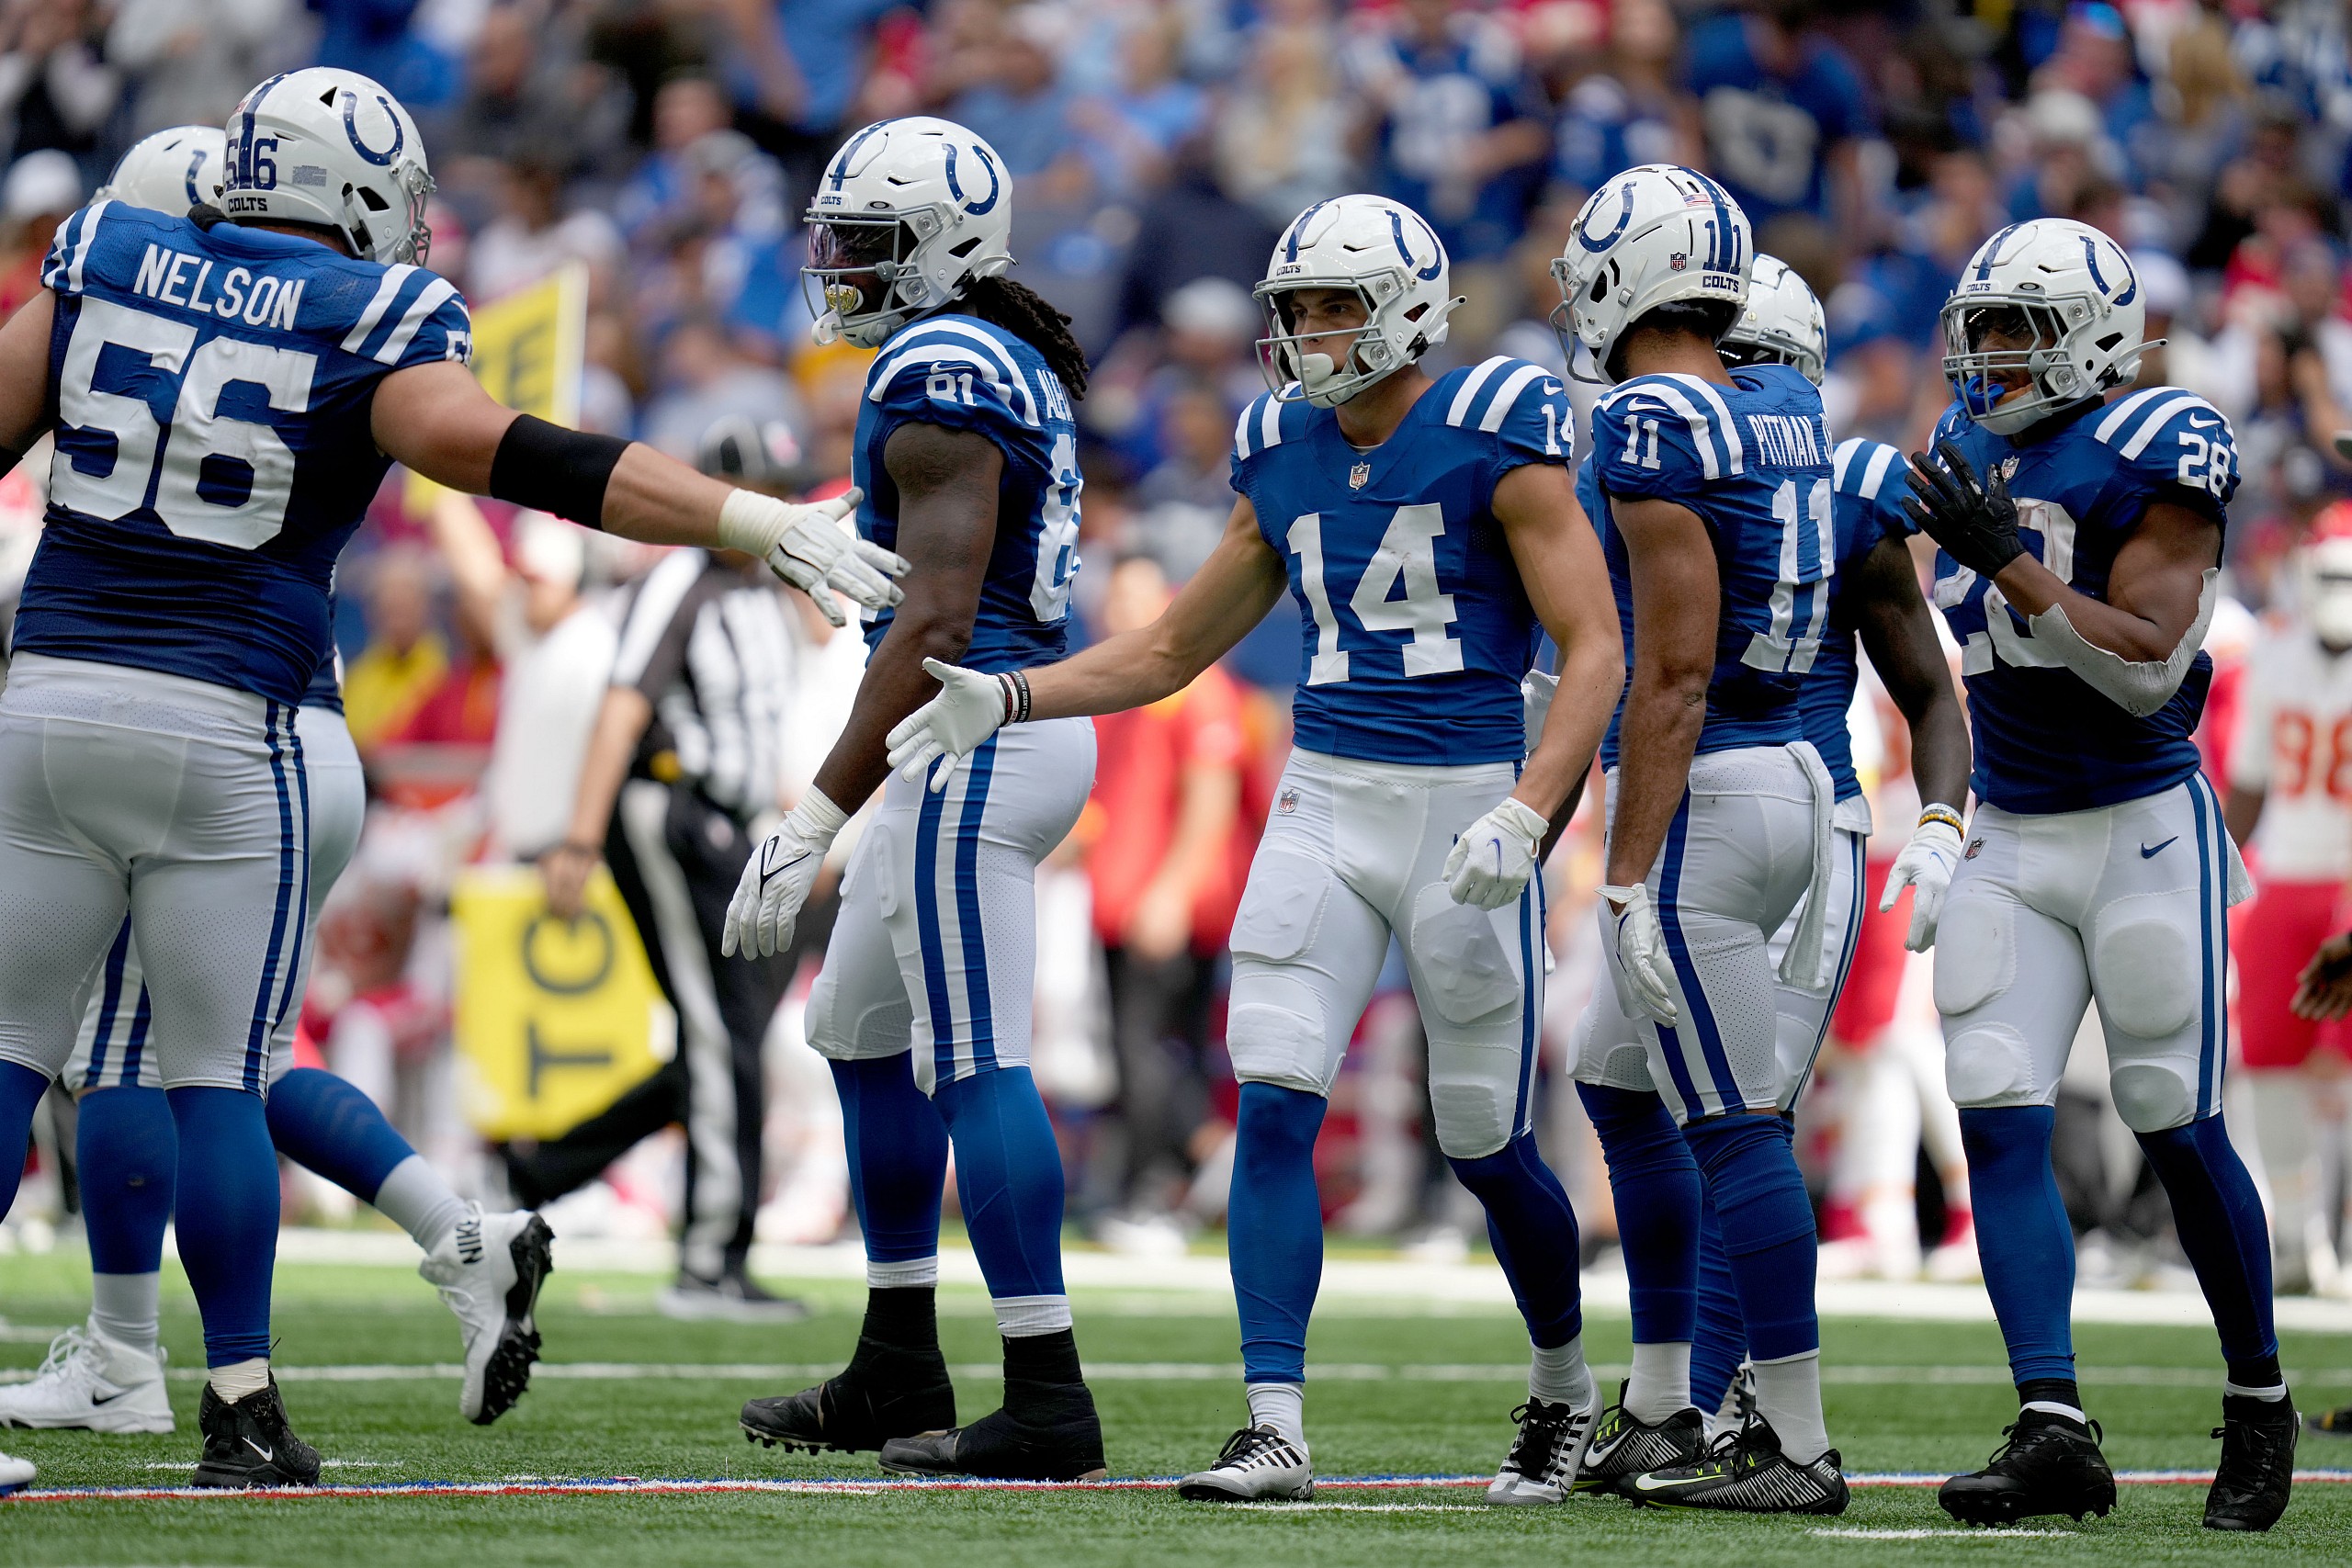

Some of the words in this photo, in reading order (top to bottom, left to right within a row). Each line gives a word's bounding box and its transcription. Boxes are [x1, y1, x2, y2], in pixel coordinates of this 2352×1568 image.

[226, 138, 278, 192] 56
[228, 197, 268, 212] COLTS
[820, 196, 842, 205] COLTS
[1277, 265, 1302, 276] COLTS
[1672, 261, 1685, 269] NFL
[1702, 220, 1741, 275] 11
[132, 243, 306, 332] NELSON
[1702, 276, 1739, 293] COLTS
[1966, 283, 1991, 292] COLTS
[926, 373, 978, 406] 81
[50, 295, 319, 550] 56
[1541, 403, 1576, 459] 14
[1621, 414, 1661, 470] 11
[1747, 415, 1821, 467] PITTMAN
[2177, 431, 2231, 498] 28
[1286, 502, 1464, 686] 14
[1739, 479, 1836, 674] 11
[1813, 1460, 1840, 1482] NIKE
